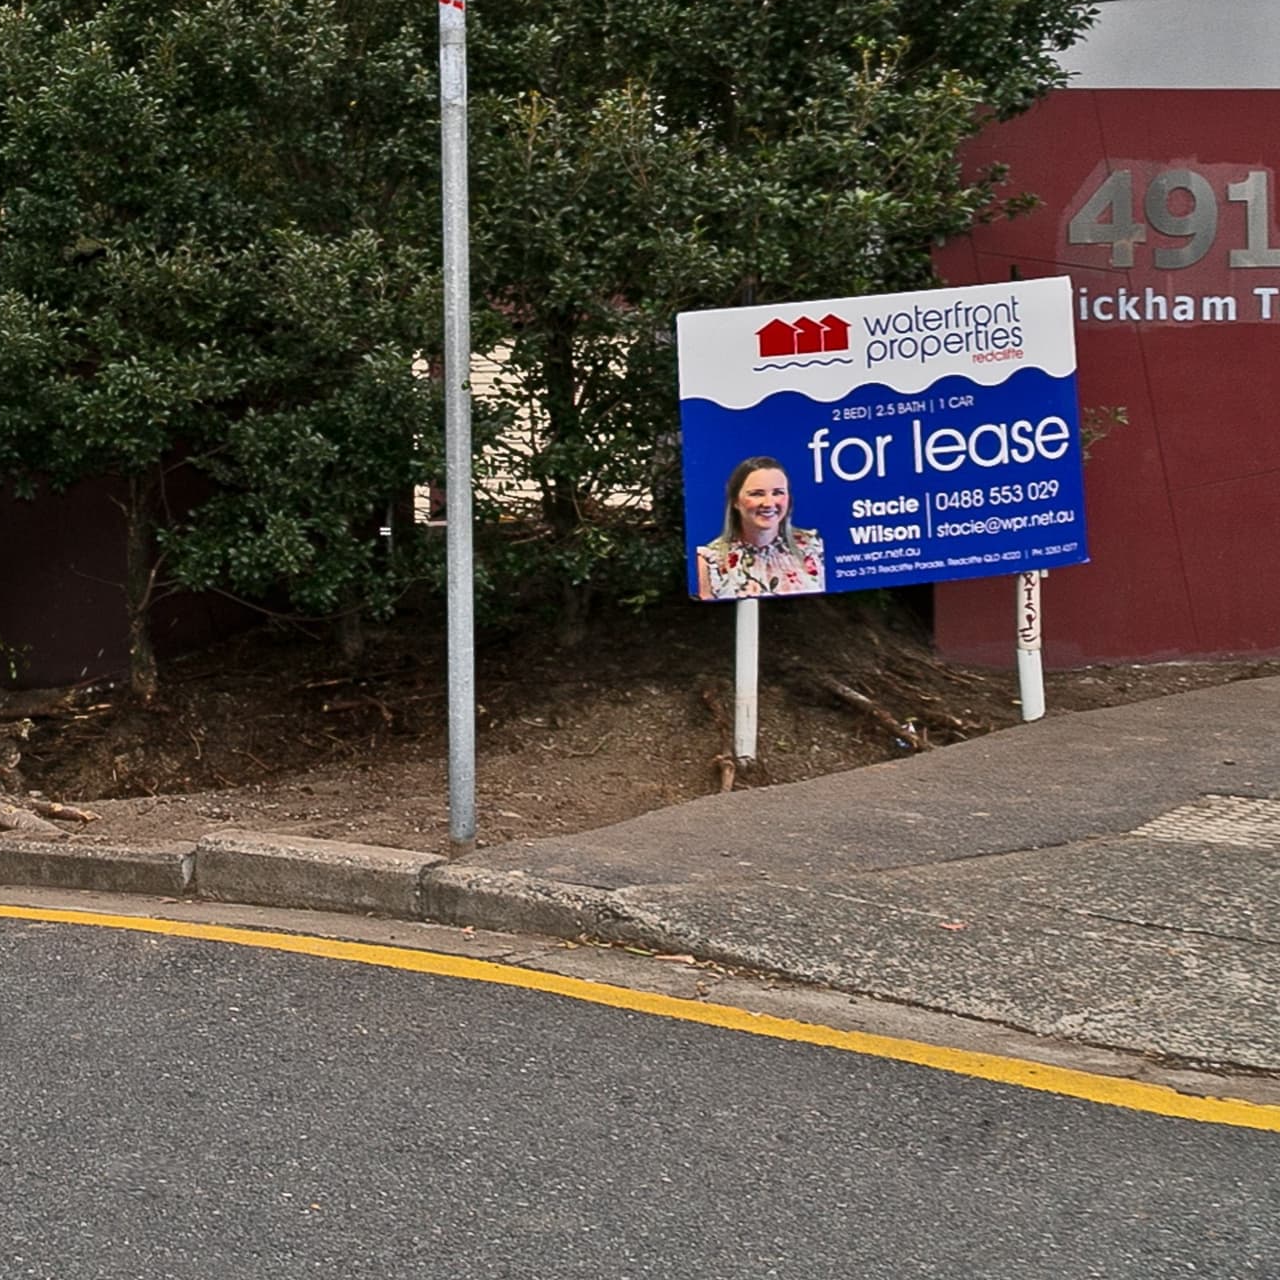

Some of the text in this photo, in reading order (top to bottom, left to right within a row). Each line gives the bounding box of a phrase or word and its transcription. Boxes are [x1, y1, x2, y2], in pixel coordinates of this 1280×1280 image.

[1068, 169, 1280, 268] 491
[863, 295, 1021, 337] waterfront
[1078, 287, 1237, 321] ickham
[867, 326, 1023, 368] properties
[972, 348, 1024, 364] redcliffe
[832, 408, 841, 421] 2
[875, 404, 895, 417] 2.5
[897, 401, 926, 414] BATH
[948, 395, 974, 409] CAR
[808, 415, 1070, 483] for lease
[852, 496, 920, 518] Stacie
[935, 479, 1059, 511] 0488 553 029
[850, 524, 921, 544] Wilson
[936, 510, 1075, 538] stacie@wpr.net.au
[834, 547, 921, 563] www.wpr.net.au
